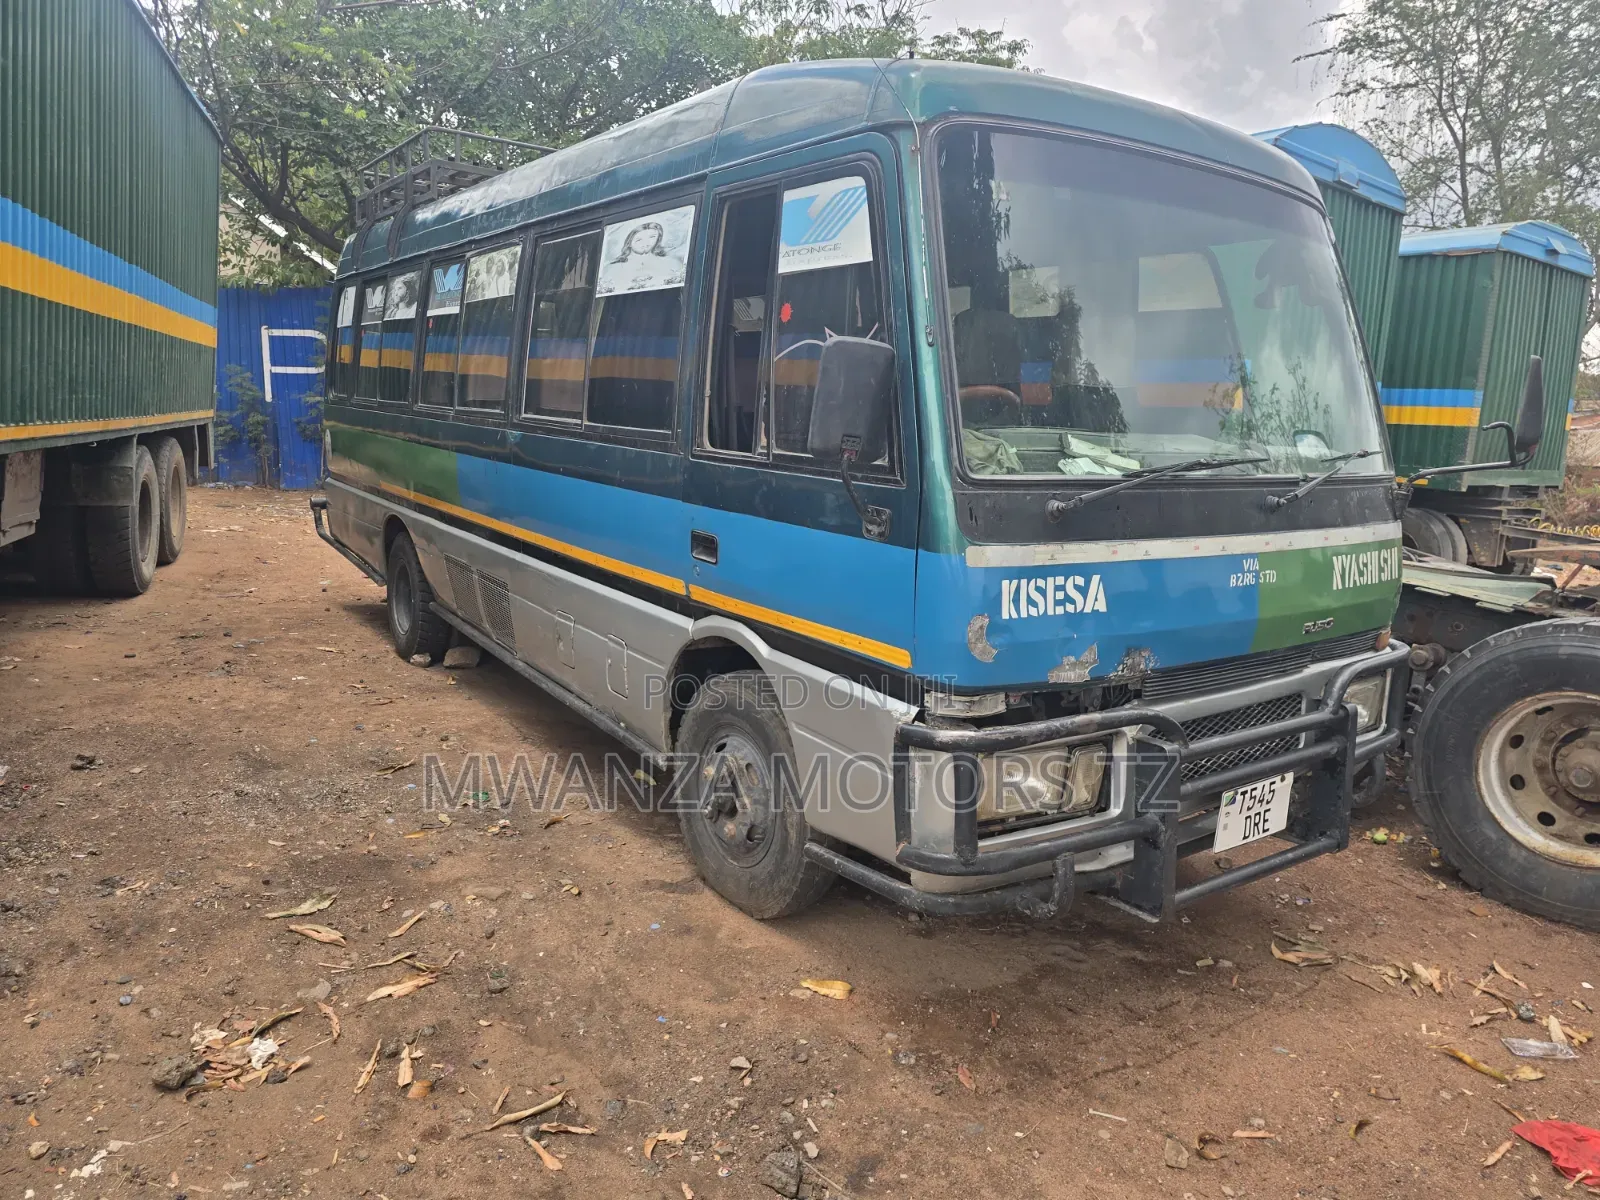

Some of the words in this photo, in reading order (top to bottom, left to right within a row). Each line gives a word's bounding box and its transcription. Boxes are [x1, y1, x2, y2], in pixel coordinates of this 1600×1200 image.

[1243, 557, 1260, 572] VIA
[1259, 569, 1277, 583] STD
[1001, 574, 1107, 619] KISESA
[1302, 617, 1334, 634] FUSO
[1239, 781, 1276, 815] T545
[1242, 808, 1271, 840] DRE
